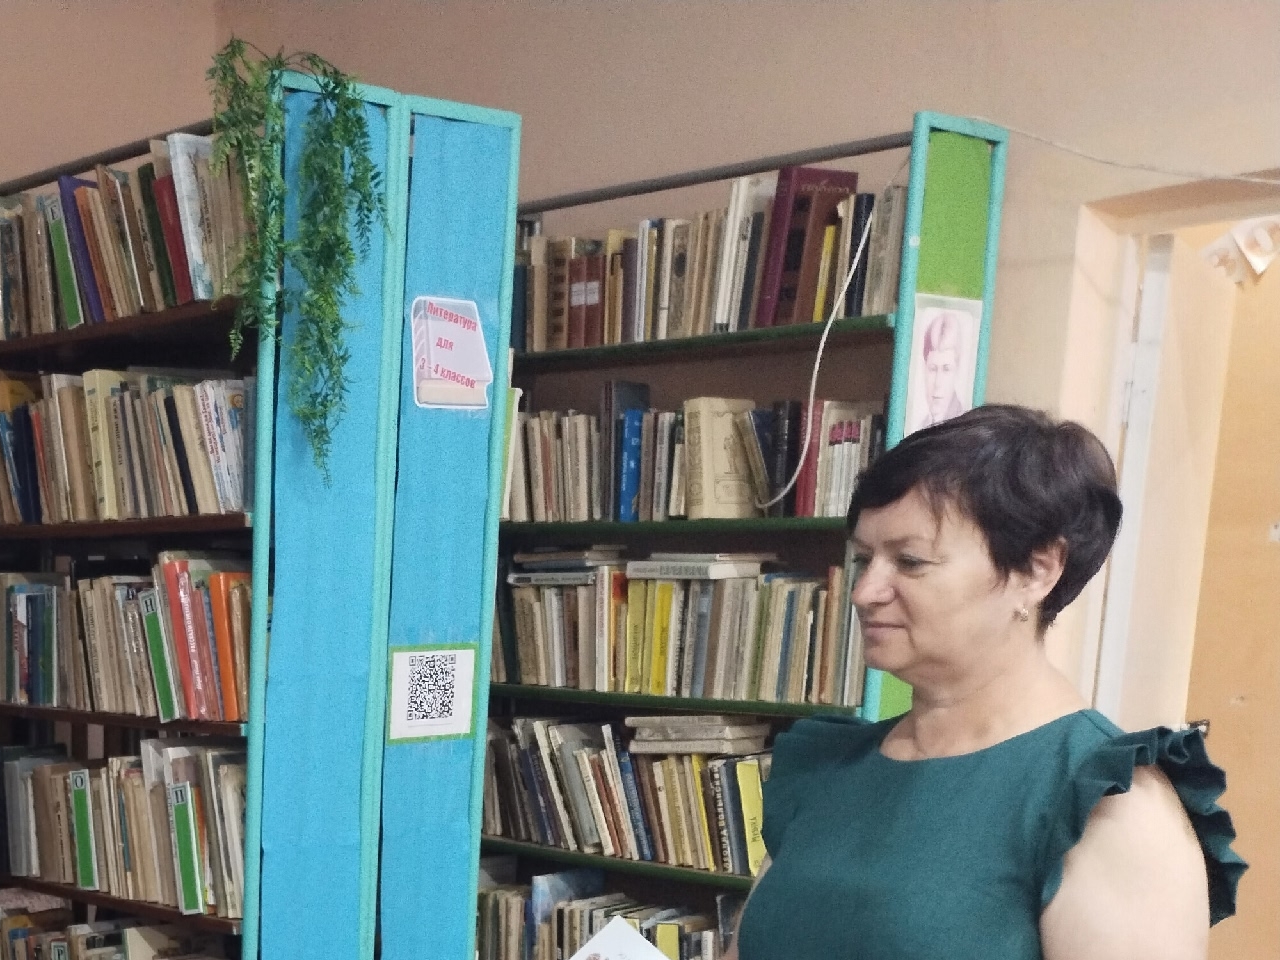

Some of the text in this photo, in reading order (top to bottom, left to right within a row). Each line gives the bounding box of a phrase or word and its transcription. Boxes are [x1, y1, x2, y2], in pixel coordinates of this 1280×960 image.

[427, 302, 477, 331] Литература
[436, 337, 454, 351] для
[420, 358, 426, 370] 3
[433, 364, 440, 374] 4
[440, 366, 476, 388] классов
[74, 775, 84, 788] О
[174, 789, 185, 803] П
